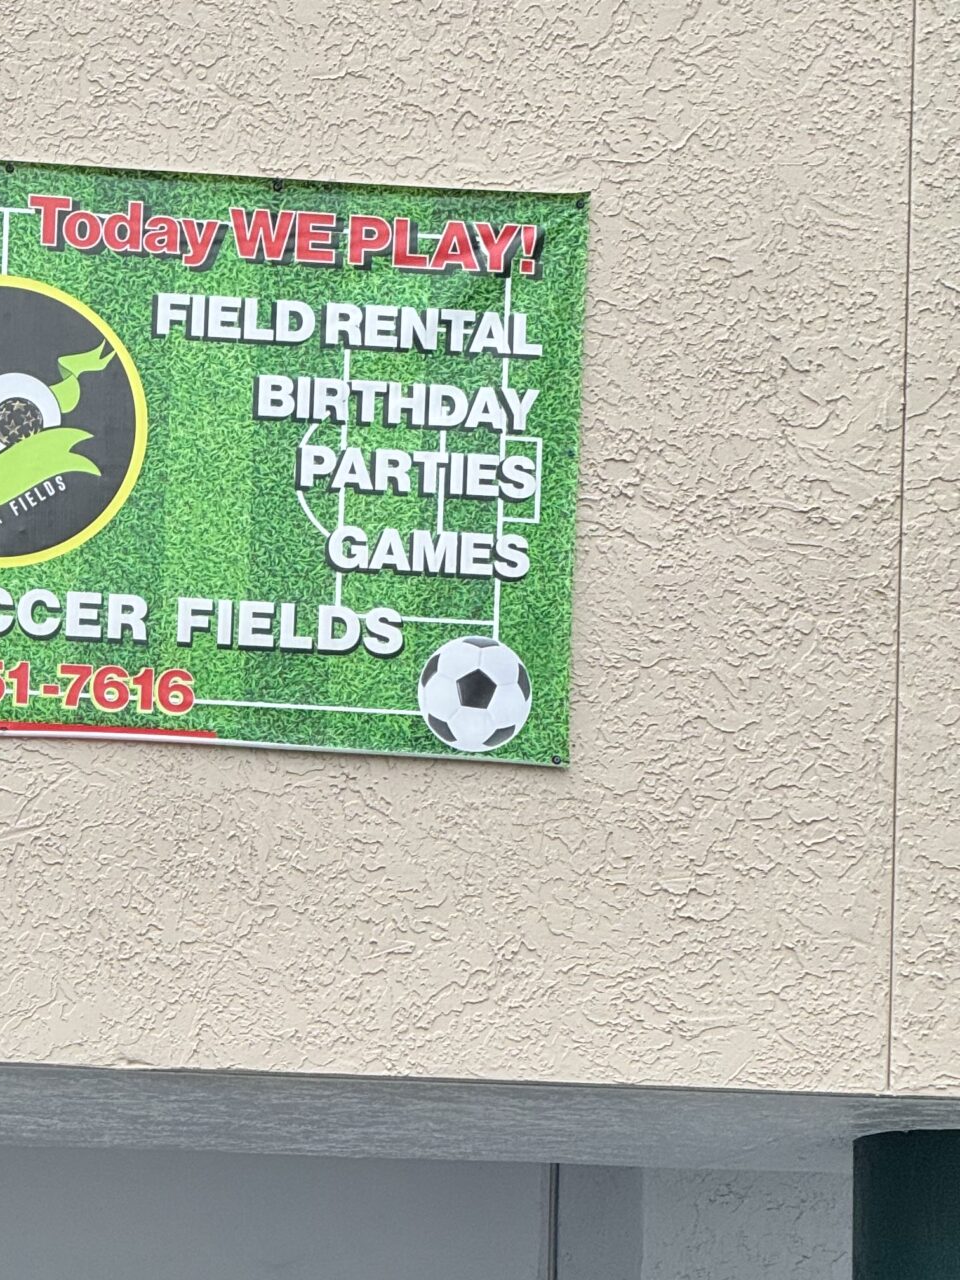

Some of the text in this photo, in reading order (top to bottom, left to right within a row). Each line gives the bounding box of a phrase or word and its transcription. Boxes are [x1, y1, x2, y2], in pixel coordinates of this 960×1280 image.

[28, 194, 539, 275] Today WE PLAY!
[155, 293, 543, 357] FIELD RENTAL
[258, 375, 540, 431] BIRTHDAY
[9, 475, 67, 517] FIELDS
[299, 446, 538, 500] PARTIES
[328, 528, 531, 579] GAMES
[176, 599, 404, 656] FIELDS
